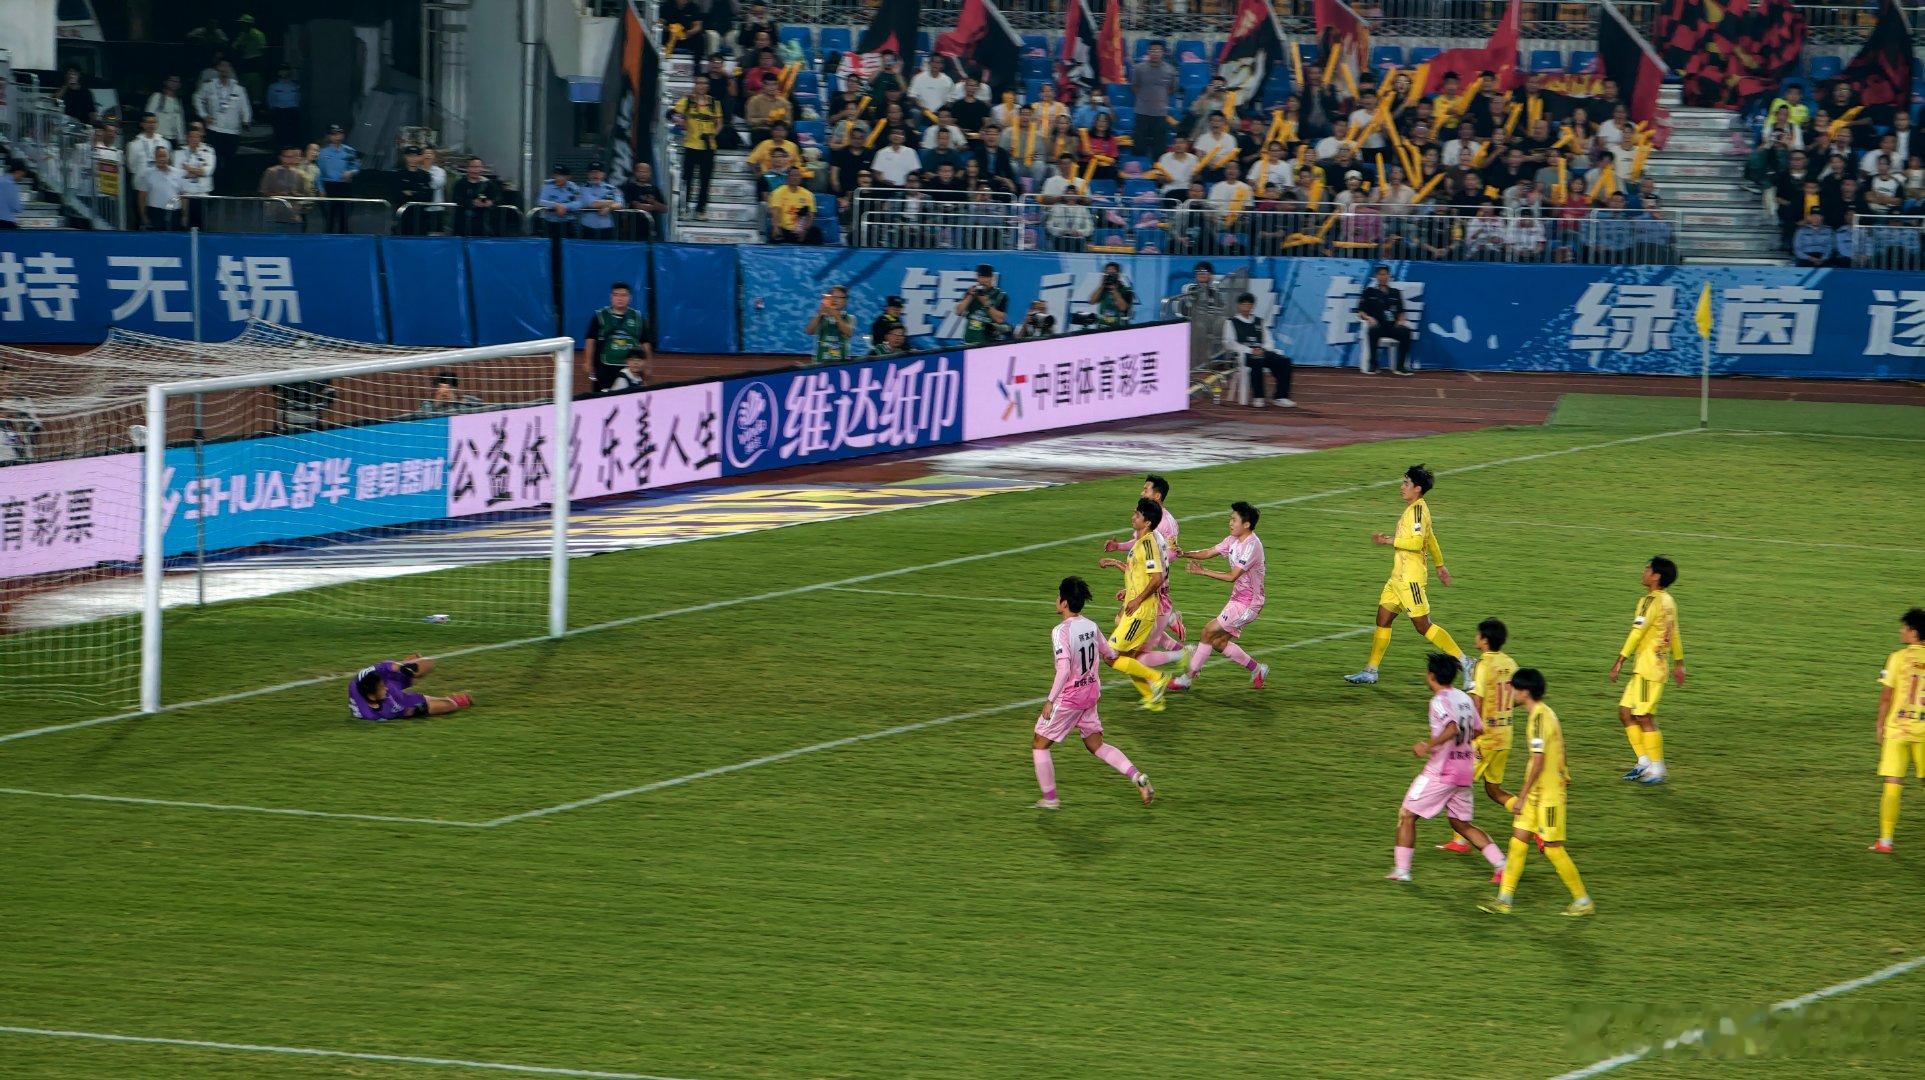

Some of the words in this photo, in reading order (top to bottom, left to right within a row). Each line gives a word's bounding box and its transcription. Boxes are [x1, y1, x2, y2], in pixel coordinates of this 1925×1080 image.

[0, 252, 302, 323] 持无锡
[779, 357, 960, 459] 维达纸巾
[1031, 351, 1159, 411] 中国体育彩票
[355, 456, 445, 500] 健身器材
[1079, 642, 1095, 675] 19
